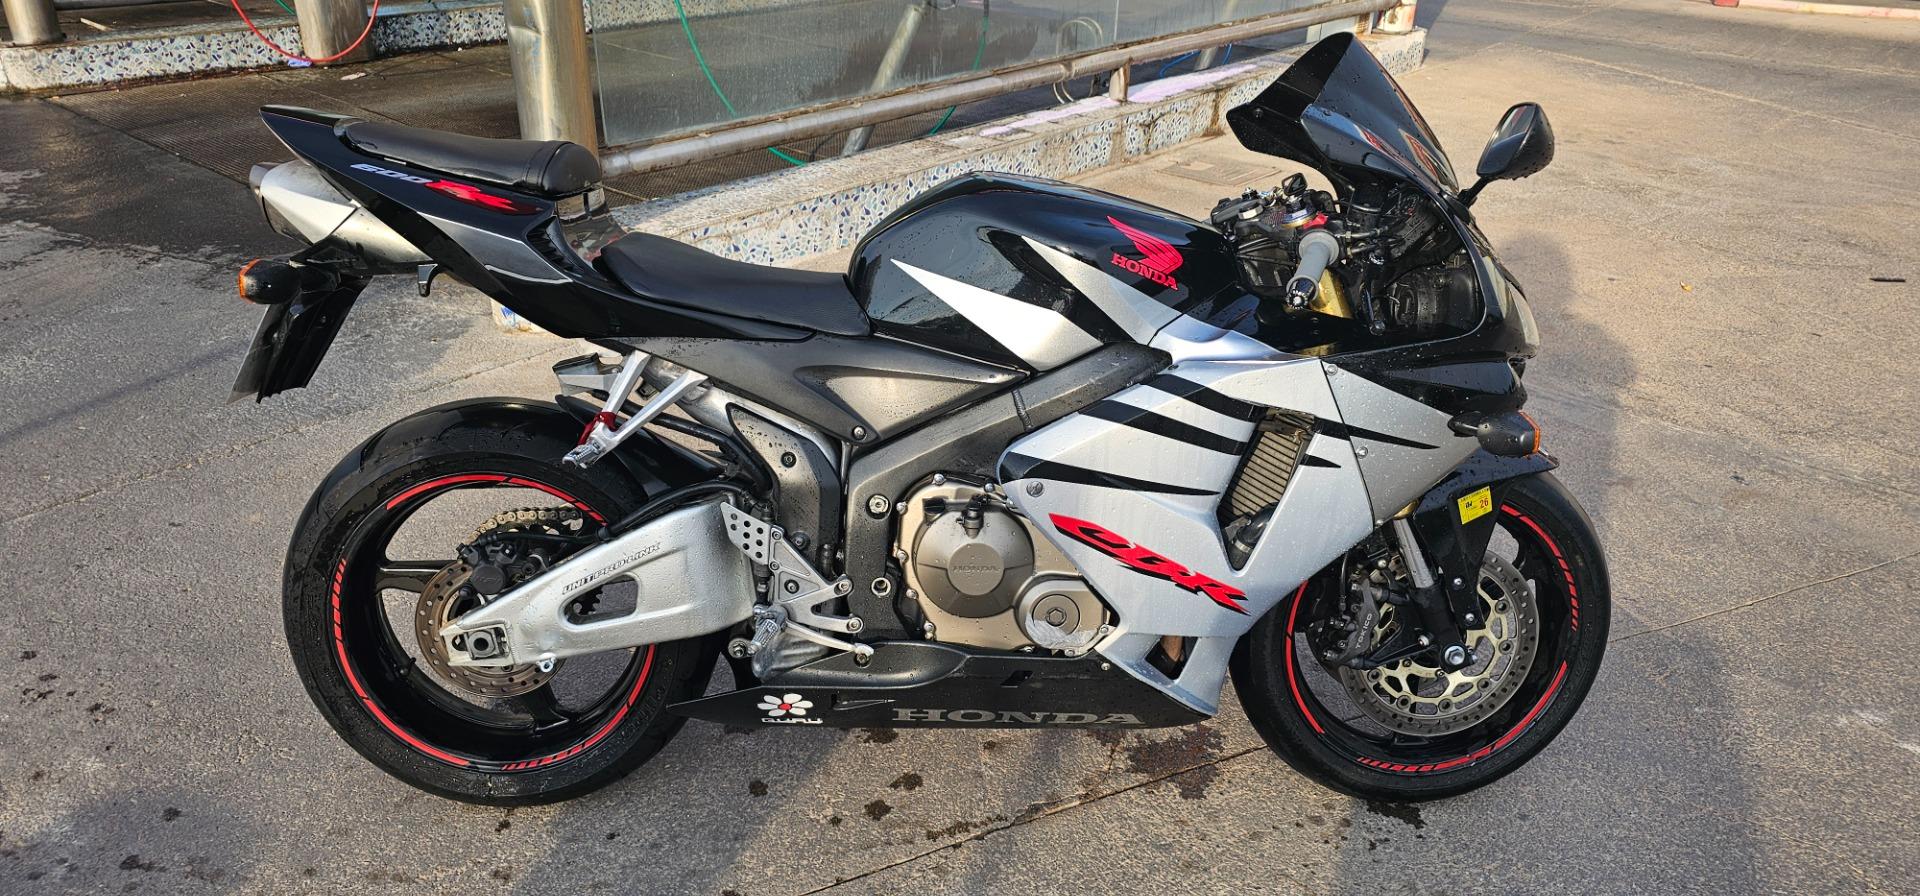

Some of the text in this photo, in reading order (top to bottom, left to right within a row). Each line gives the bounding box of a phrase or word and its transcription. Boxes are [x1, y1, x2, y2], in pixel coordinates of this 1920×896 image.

[1110, 252, 1179, 291] HONDA
[1479, 498, 1489, 508] 26
[1048, 513, 1252, 616] CBR
[1355, 613, 1373, 649] TOKICO
[892, 708, 1146, 725] HONDA
